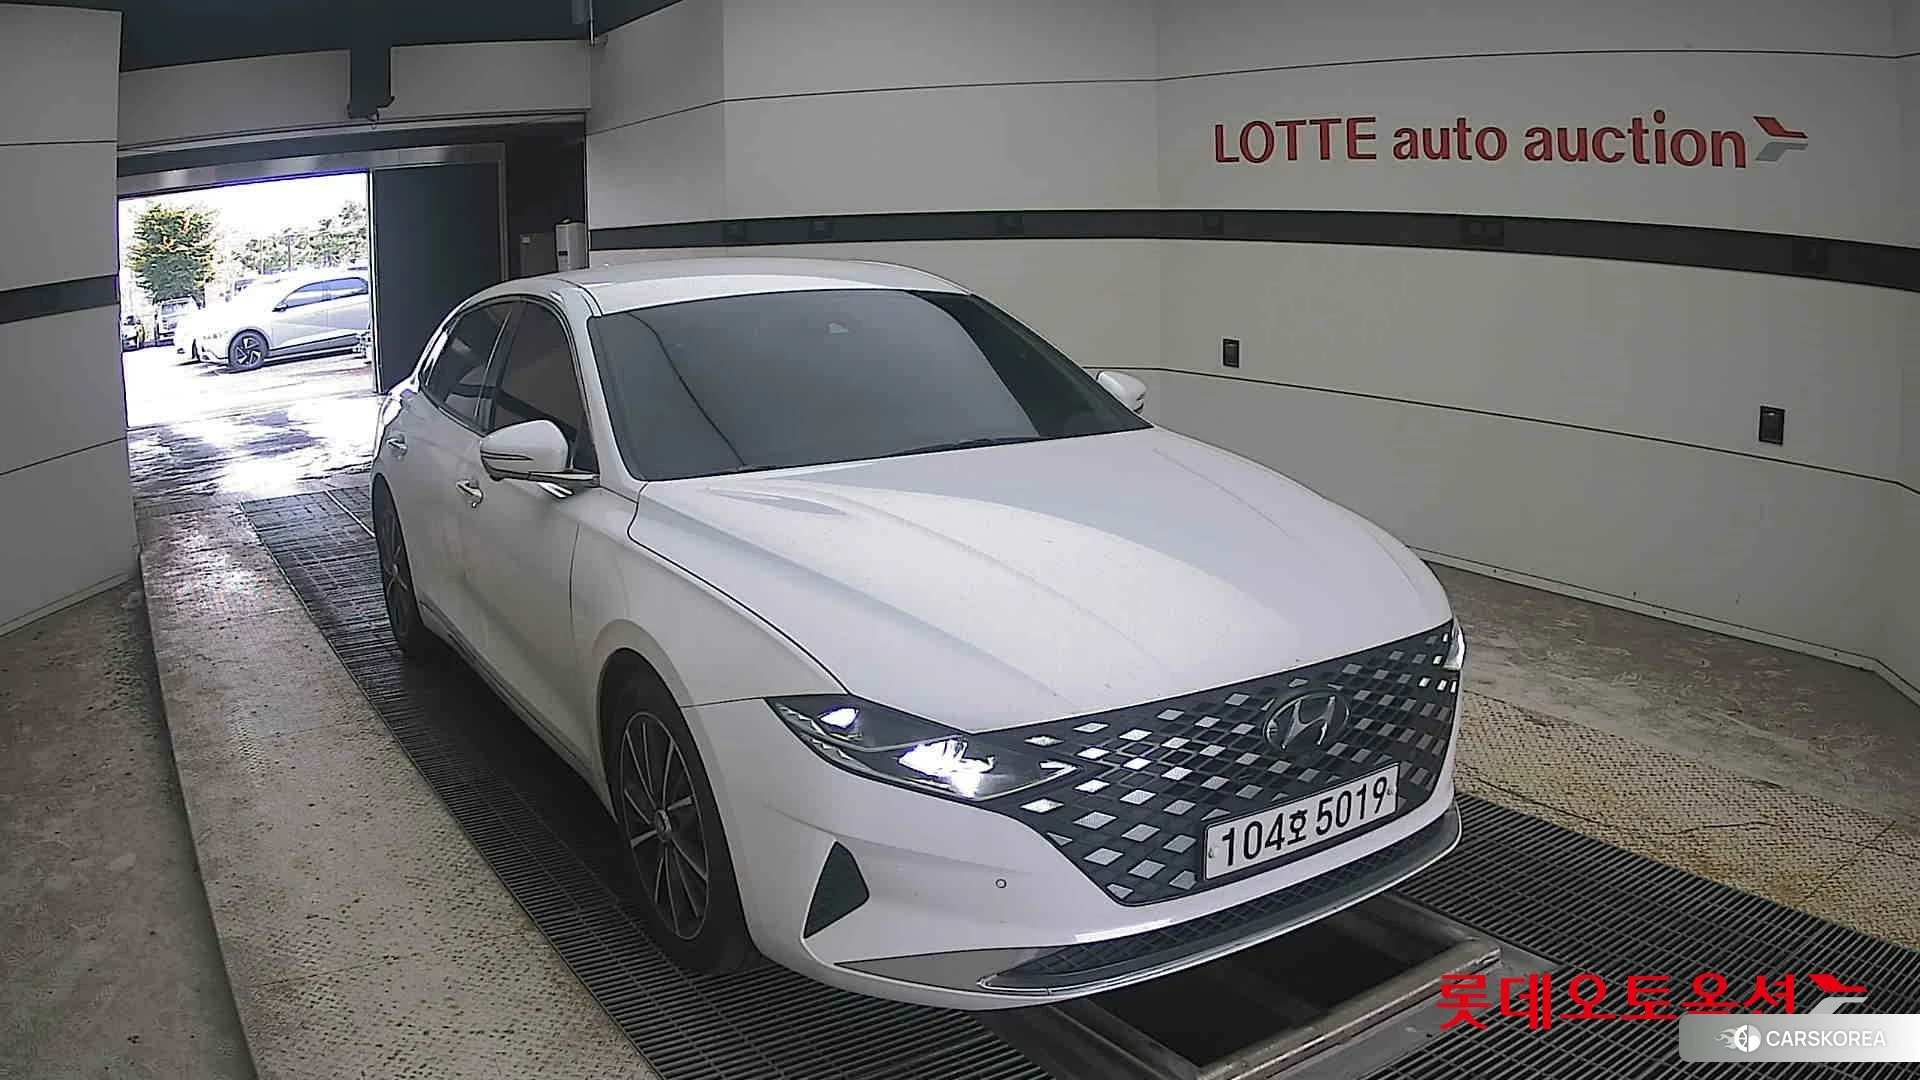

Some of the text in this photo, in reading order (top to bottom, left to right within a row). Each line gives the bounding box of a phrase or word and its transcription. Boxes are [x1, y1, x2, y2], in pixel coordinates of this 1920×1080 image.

[1214, 109, 1747, 169] LOTTE auto auction
[1315, 776, 1388, 836] 5019
